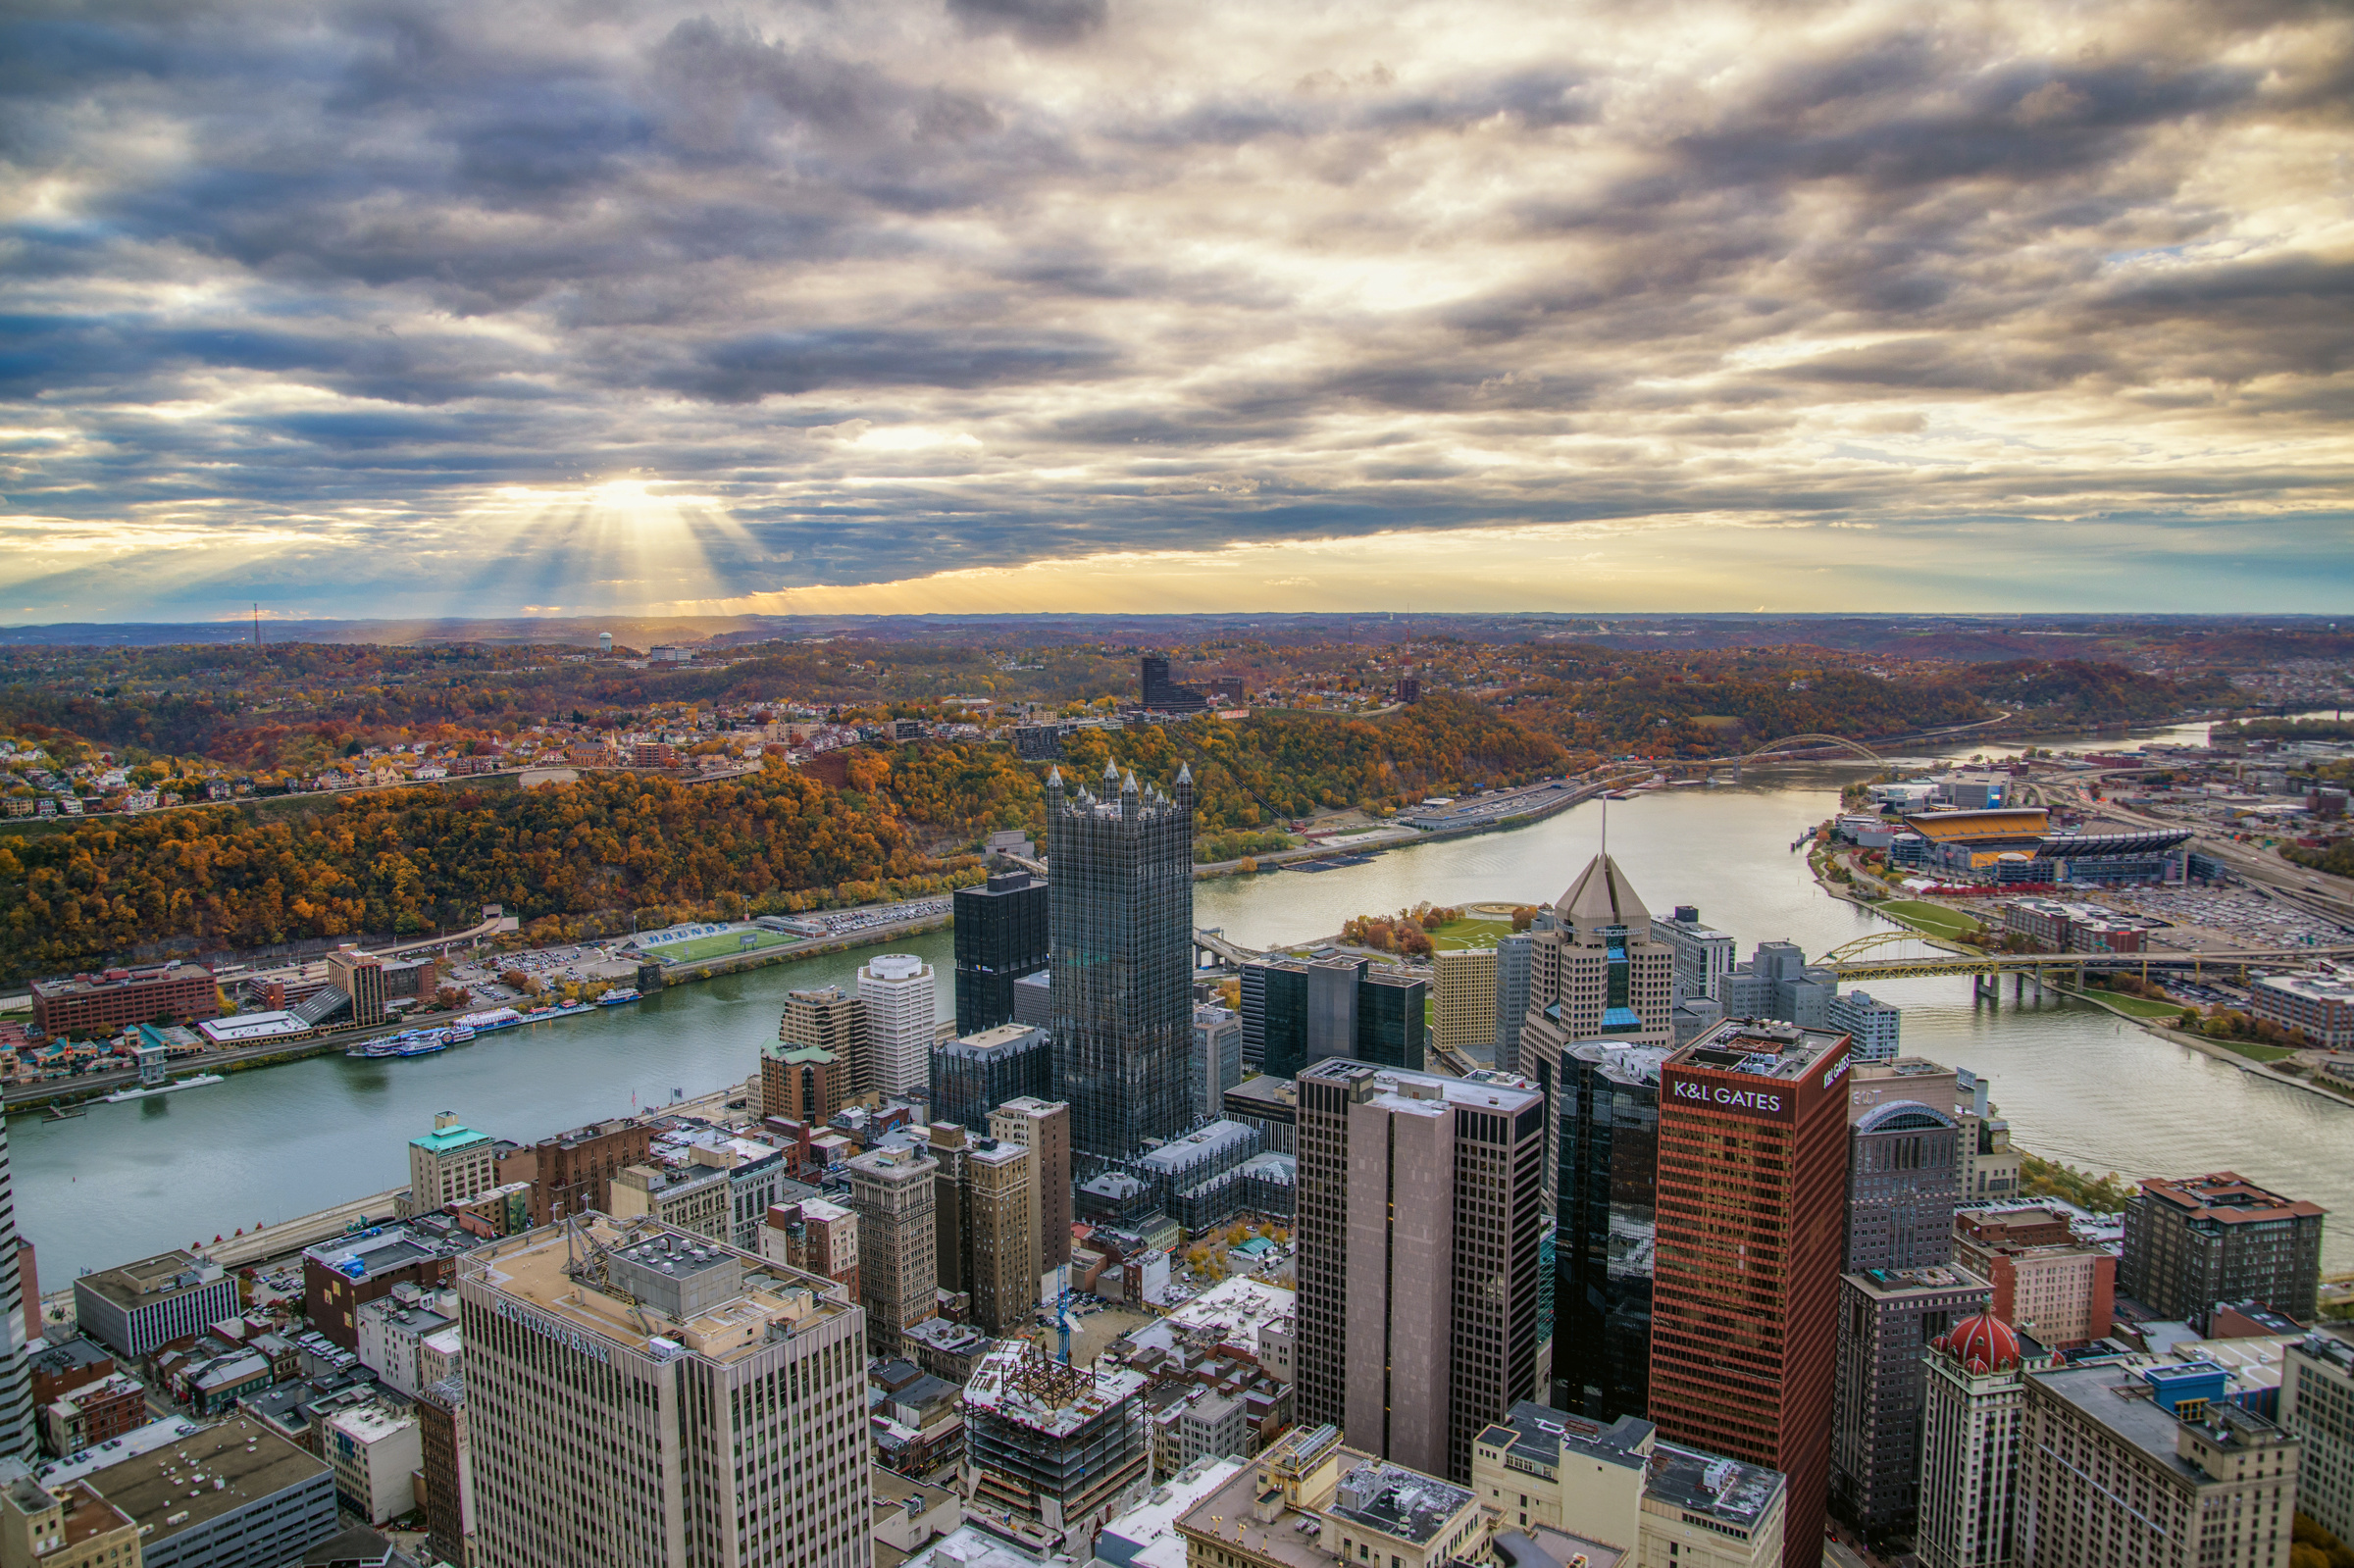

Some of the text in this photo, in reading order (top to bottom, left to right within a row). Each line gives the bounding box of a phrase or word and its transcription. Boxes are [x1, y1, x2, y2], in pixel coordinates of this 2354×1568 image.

[648, 923, 729, 944] HOUNDS
[1834, 1052, 1851, 1079] GATES
[1674, 1081, 1781, 1112] K&L GATES
[1852, 1089, 1882, 1105] EQT
[509, 1304, 609, 1364] CITIZENS BANK
